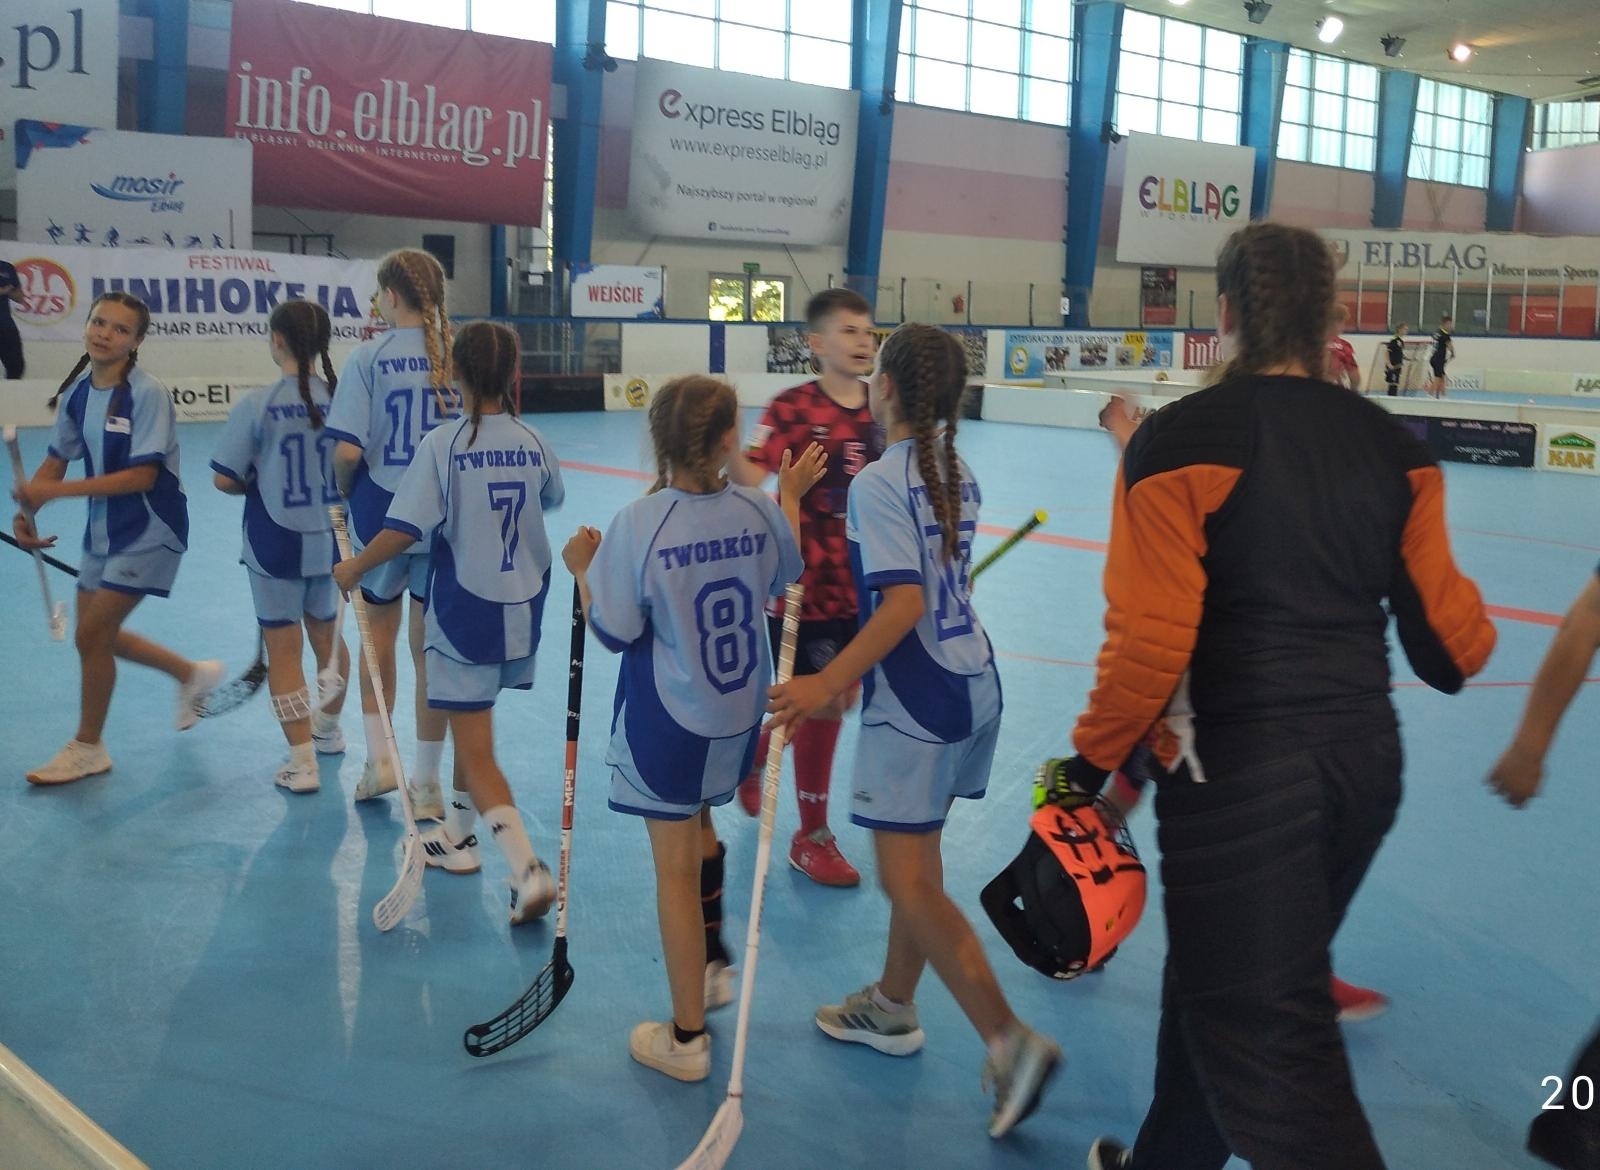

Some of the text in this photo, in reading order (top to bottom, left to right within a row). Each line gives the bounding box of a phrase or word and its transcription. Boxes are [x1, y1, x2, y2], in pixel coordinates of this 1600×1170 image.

[234, 61, 543, 168] info.elblag.pl
[771, 109, 841, 146] Elbląg
[110, 171, 185, 196] mosir
[188, 254, 276, 273] FESTIWAL
[454, 444, 543, 472] TWORKÓW
[487, 480, 526, 573] 7
[694, 576, 759, 696] 8
